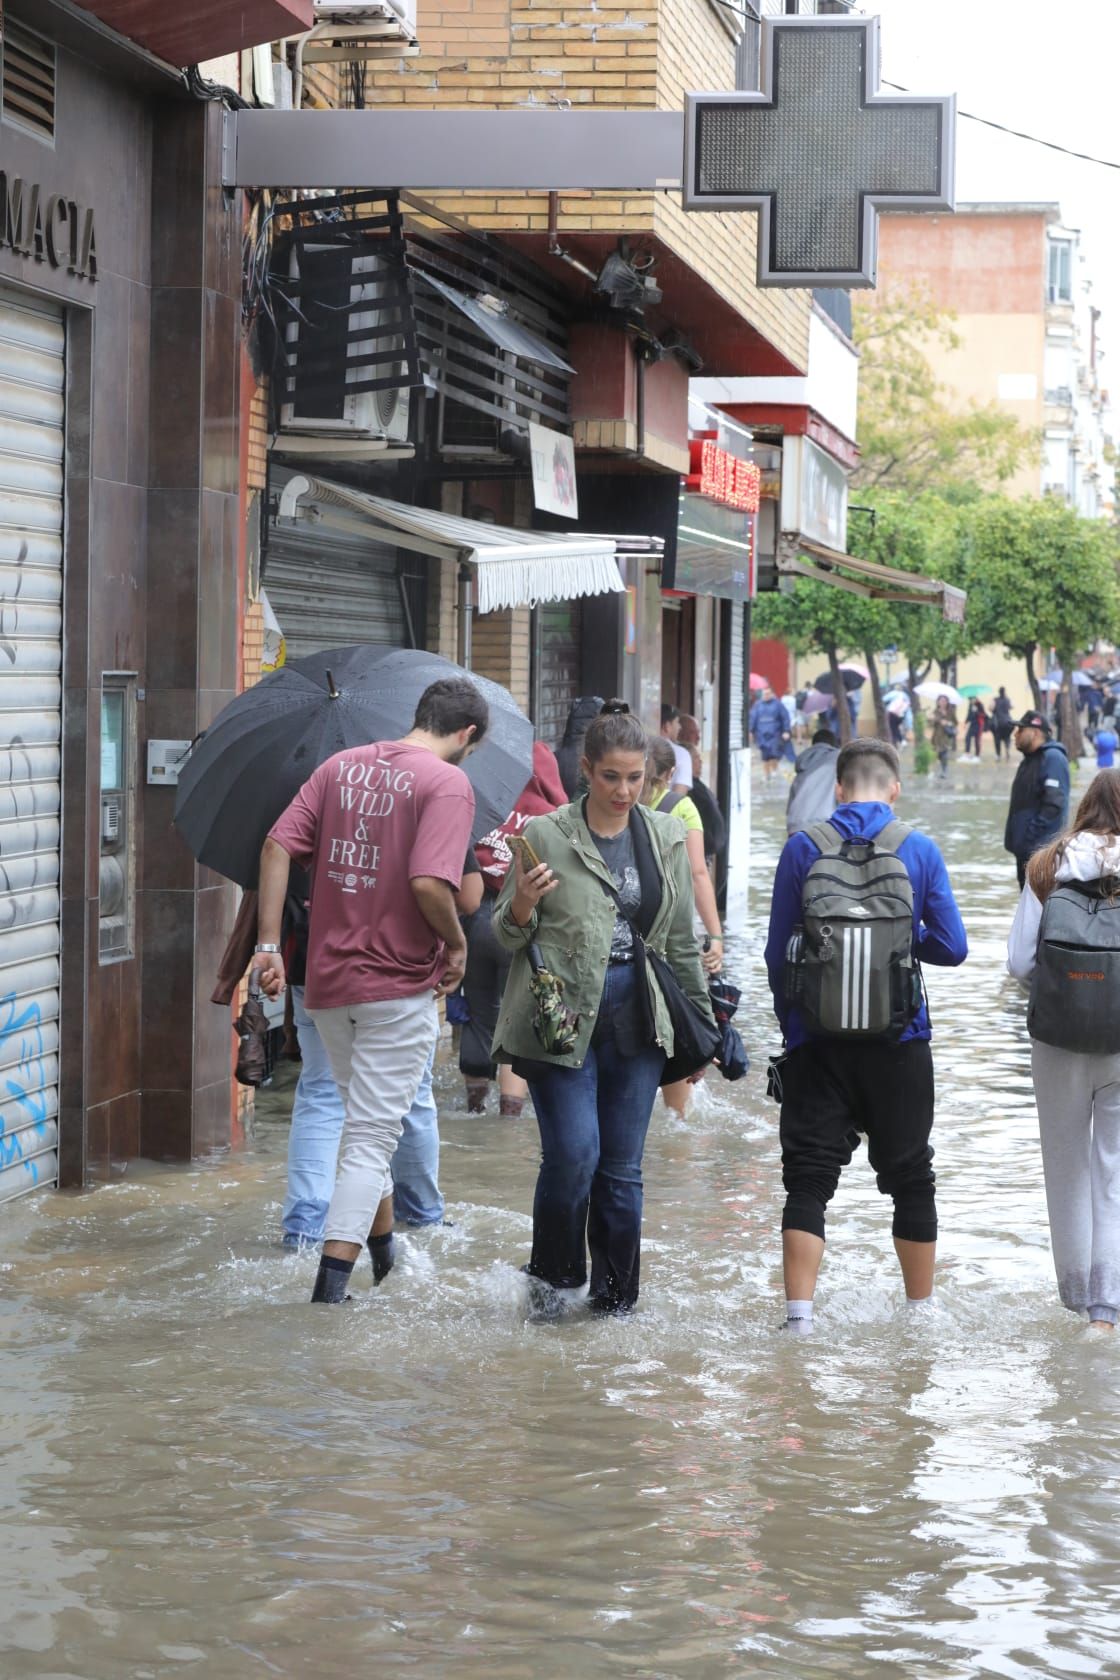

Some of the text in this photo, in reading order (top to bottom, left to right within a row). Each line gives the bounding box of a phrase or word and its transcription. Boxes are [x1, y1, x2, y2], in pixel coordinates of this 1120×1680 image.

[336, 759, 415, 799] YOUNG,
[339, 785, 394, 817] WILD
[354, 817, 369, 842] &
